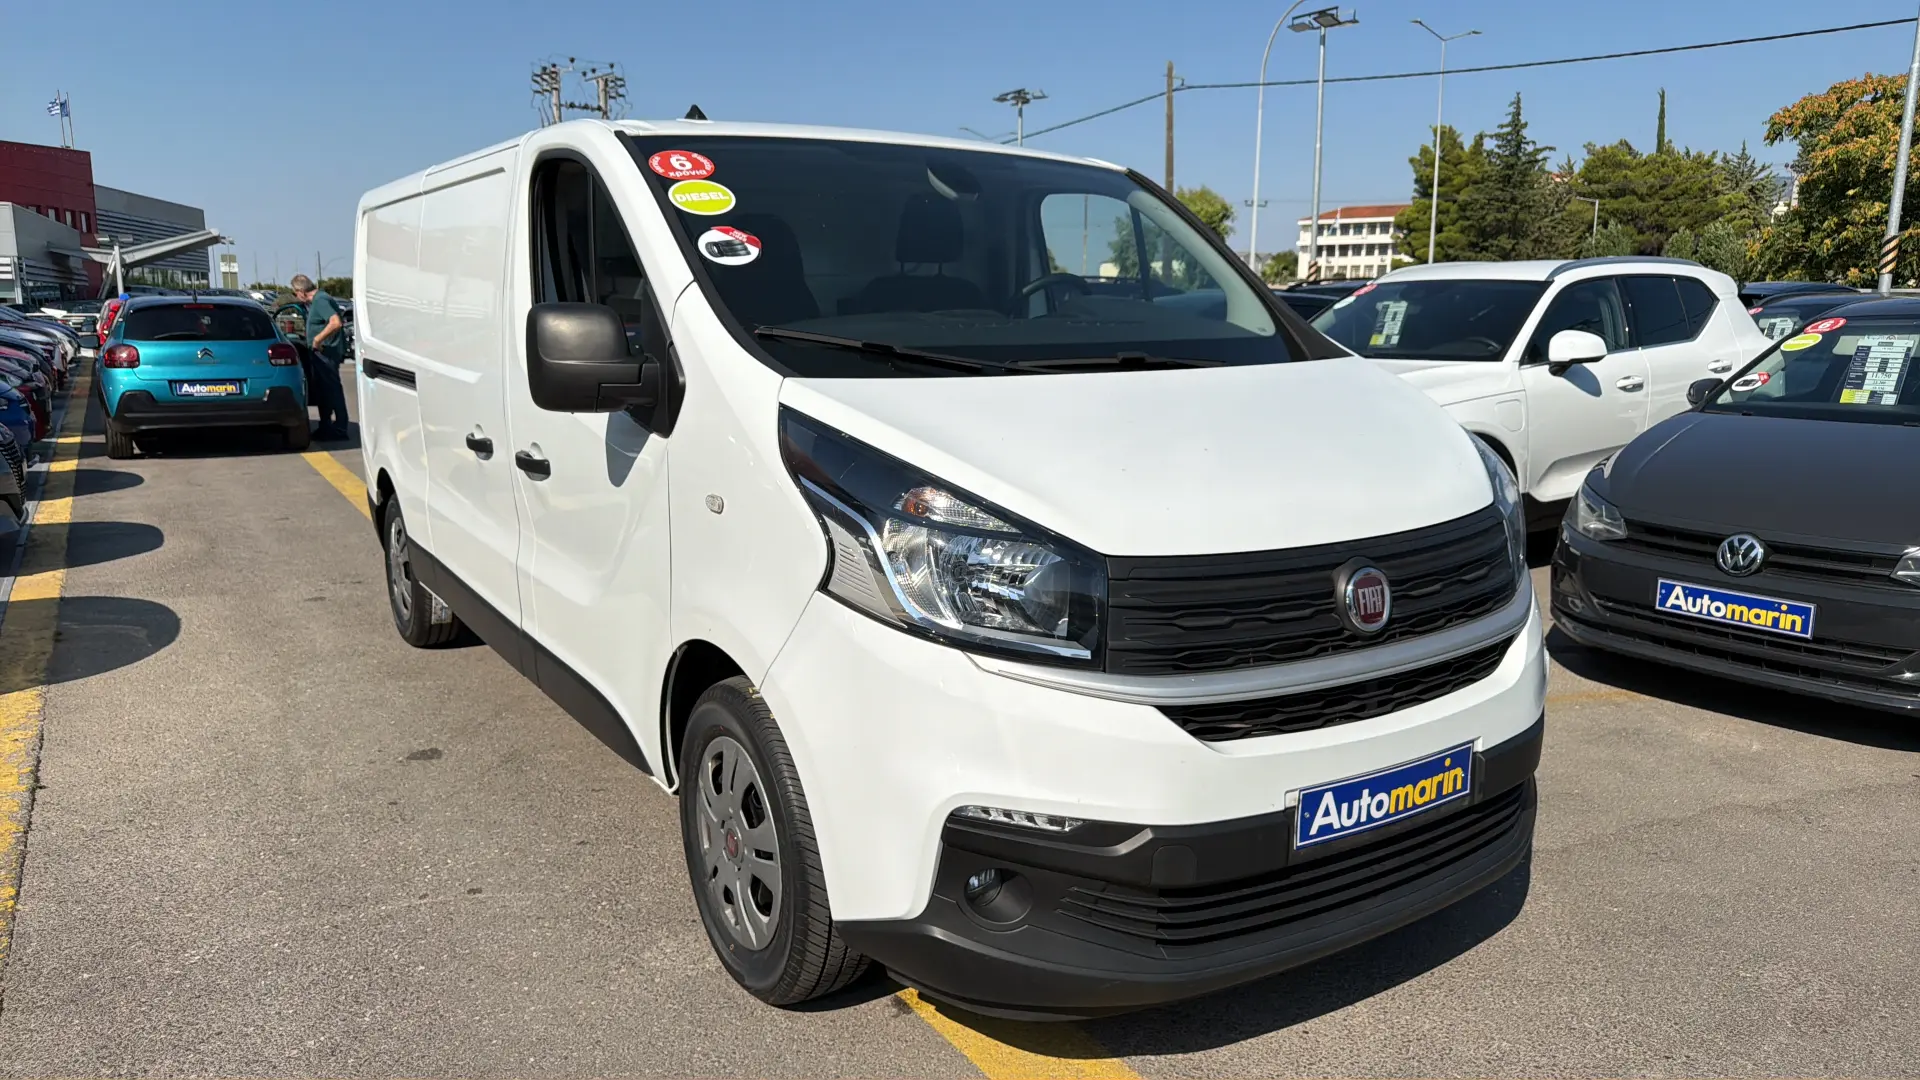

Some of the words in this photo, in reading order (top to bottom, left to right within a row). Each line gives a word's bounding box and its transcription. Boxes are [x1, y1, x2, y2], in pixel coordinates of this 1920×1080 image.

[669, 155, 693, 171] 6
[675, 191, 729, 203] DIESEL
[1817, 319, 1835, 330] 6
[182, 382, 236, 393] Automarin
[1357, 585, 1383, 616] FIAT
[1665, 586, 1802, 632] Automarin
[1309, 758, 1463, 836] Automarin
